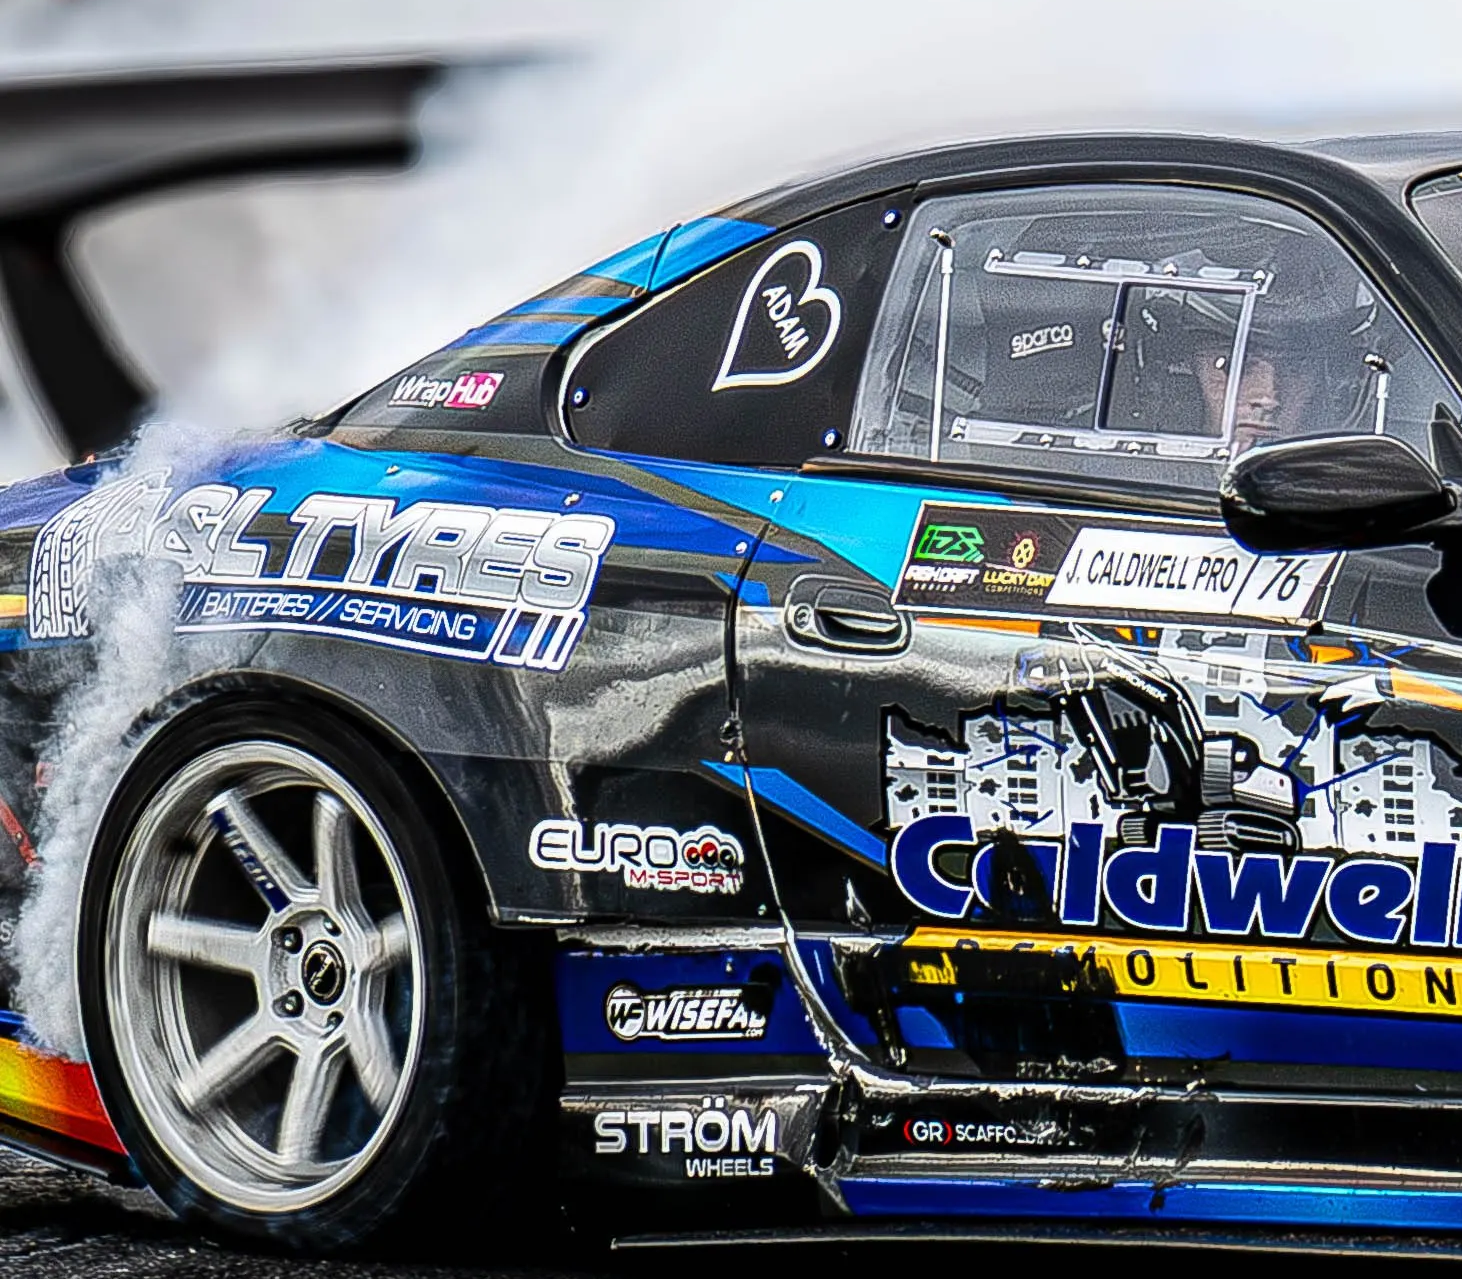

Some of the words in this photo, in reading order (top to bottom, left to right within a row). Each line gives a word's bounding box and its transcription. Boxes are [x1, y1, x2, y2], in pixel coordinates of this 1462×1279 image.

[762, 285, 810, 359] ADAM
[1012, 324, 1073, 354] sparco
[290, 493, 616, 610] TYRES
[1066, 548, 1083, 584] J.
[1087, 550, 1189, 592] CALDWELL
[1198, 556, 1238, 593] PRO
[982, 570, 1026, 585] LUCKY
[1027, 573, 1055, 587] DAY
[1259, 557, 1308, 601] 76
[202, 592, 314, 617] BATTERIES
[339, 598, 476, 639] SERVICING
[534, 825, 680, 870] EURO
[629, 868, 741, 890] M-SPORT
[955, 937, 1458, 1007] OLITION
[594, 1096, 777, 1154] STRÖM
[685, 1157, 774, 1178] WHEELS
